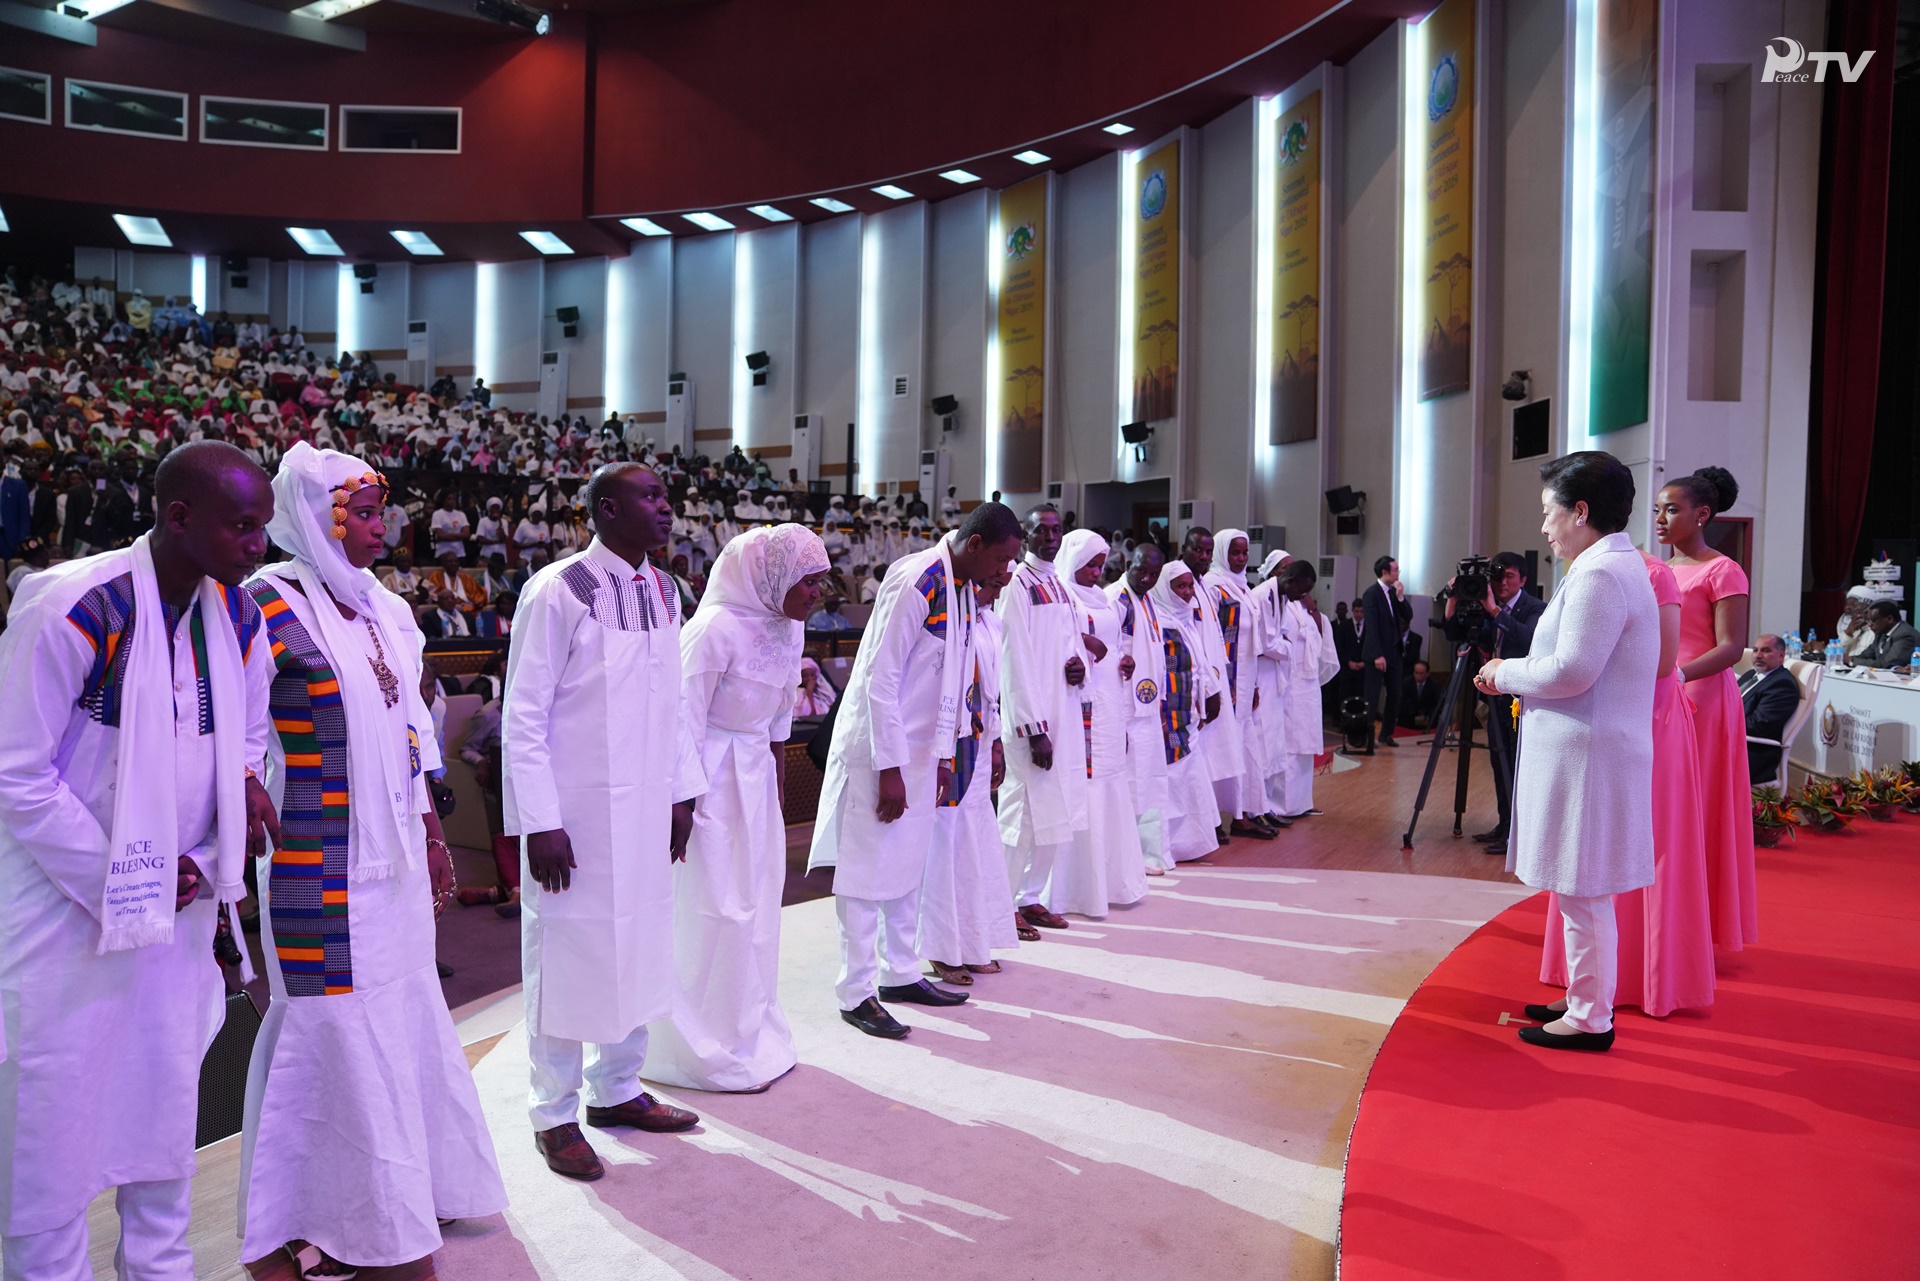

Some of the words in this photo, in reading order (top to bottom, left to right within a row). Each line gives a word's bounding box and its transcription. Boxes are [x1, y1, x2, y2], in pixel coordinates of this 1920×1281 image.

[1849, 705, 1871, 718] SOMMET
[1841, 715, 1878, 733] CONTINENTAL
[1844, 742, 1860, 754] NIGER
[1861, 745, 1875, 758] 2019
